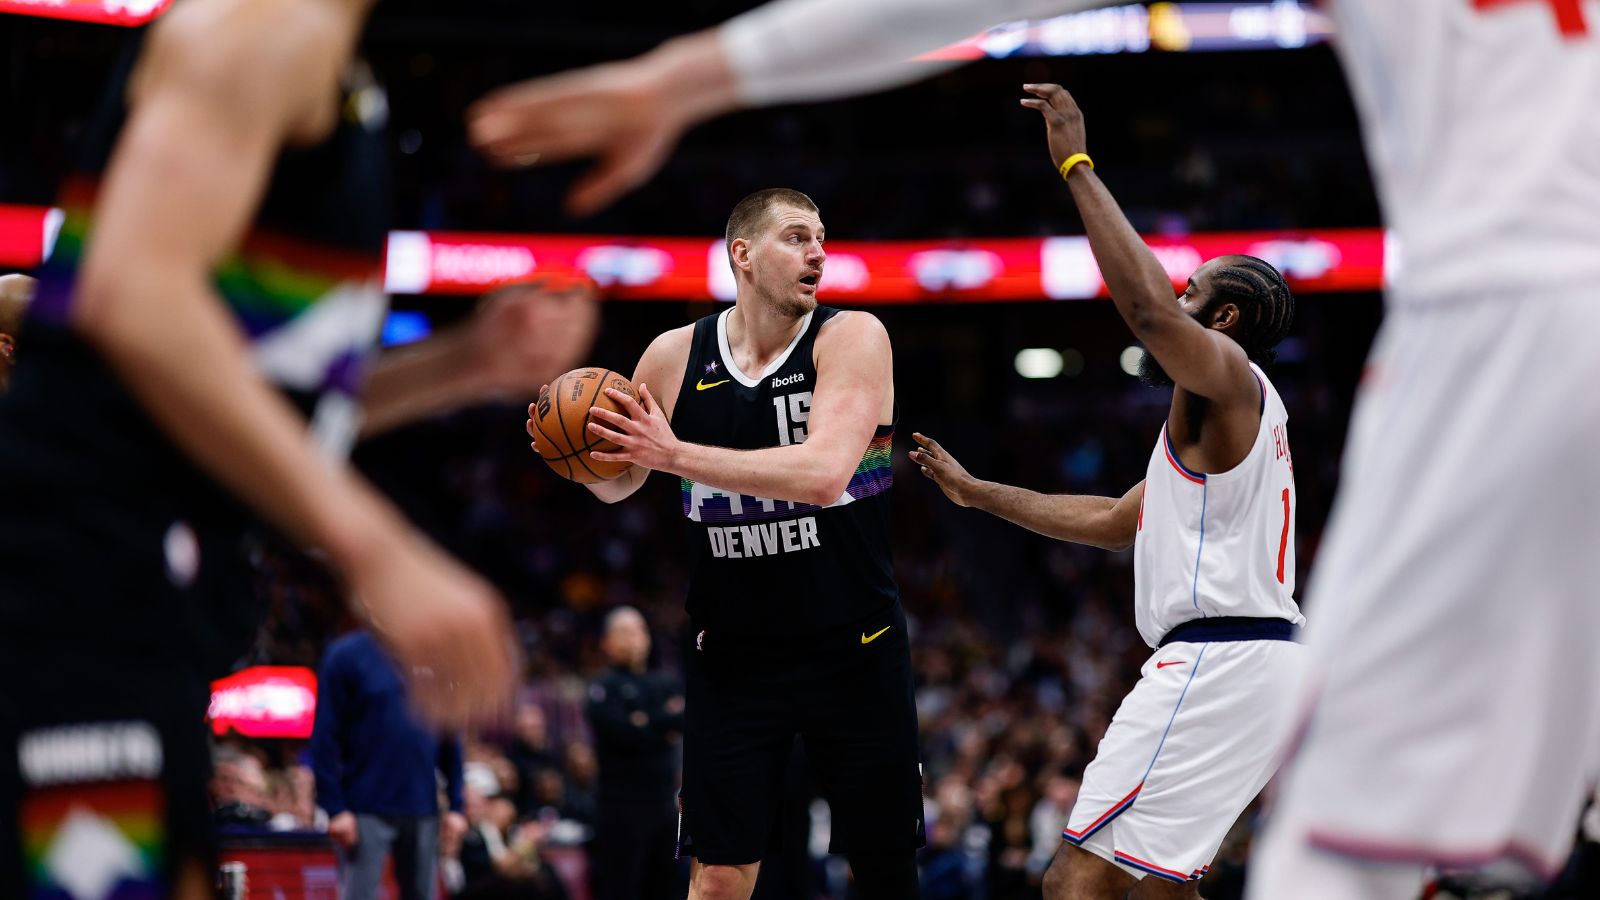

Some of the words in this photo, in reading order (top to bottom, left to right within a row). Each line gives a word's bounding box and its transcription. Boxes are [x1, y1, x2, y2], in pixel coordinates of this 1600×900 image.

[771, 373, 805, 389] ibotta
[773, 391, 813, 446] 15
[707, 516, 821, 559] DENVER
[1277, 488, 1290, 584] 1
